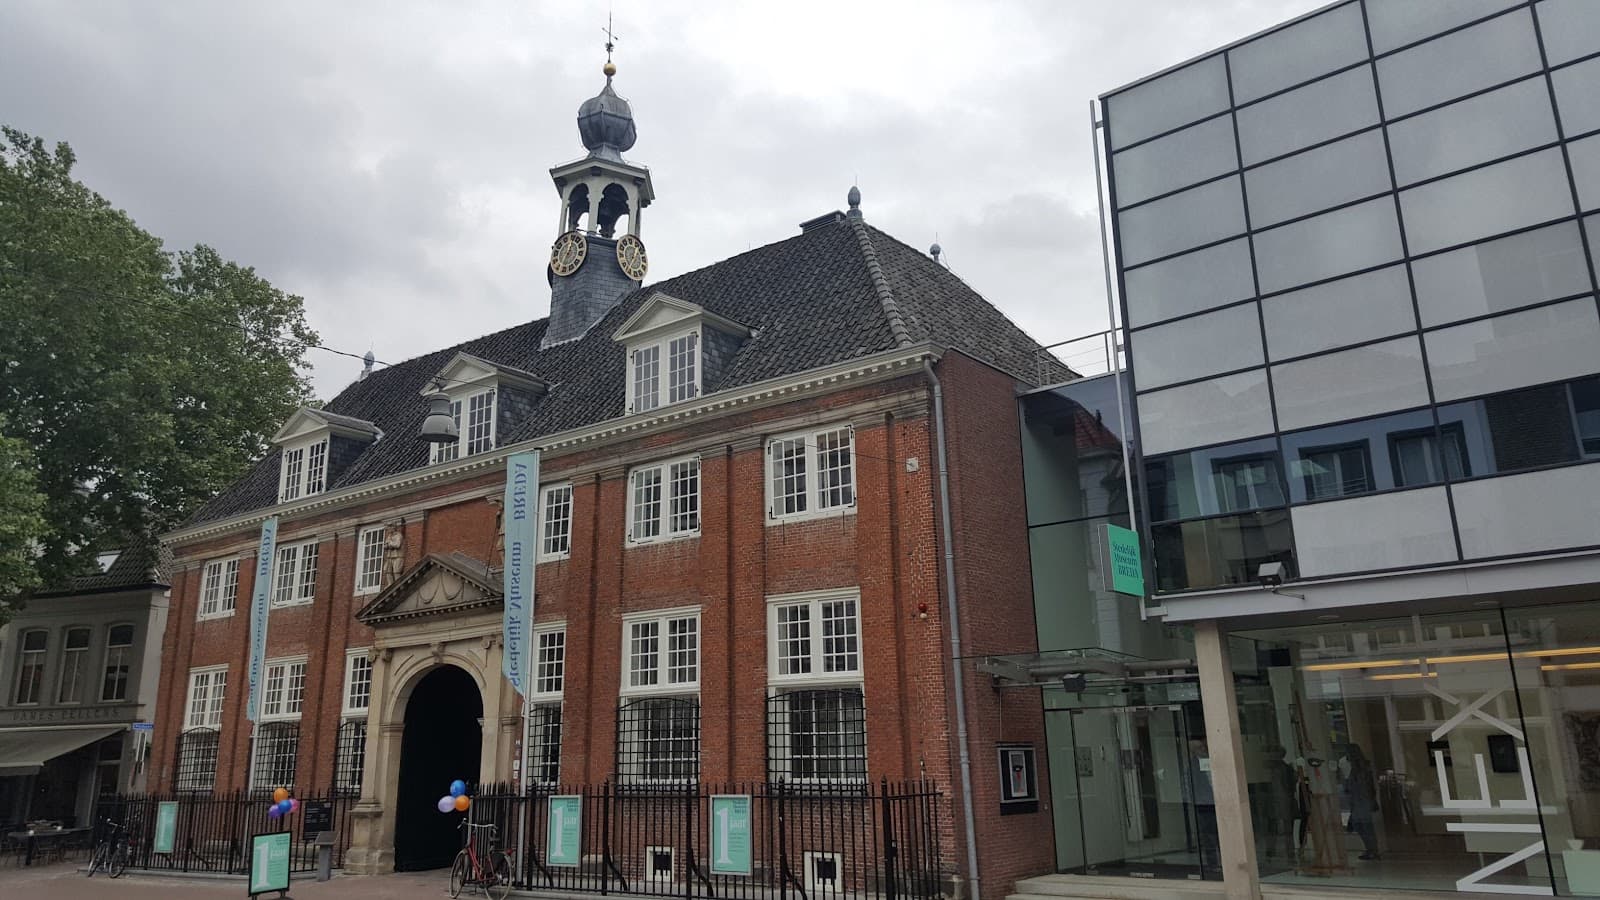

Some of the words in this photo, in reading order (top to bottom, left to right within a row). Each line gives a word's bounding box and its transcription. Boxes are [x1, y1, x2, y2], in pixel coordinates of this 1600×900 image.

[552, 807, 564, 857] 1
[716, 808, 732, 864] 1
[256, 842, 270, 888] 1
